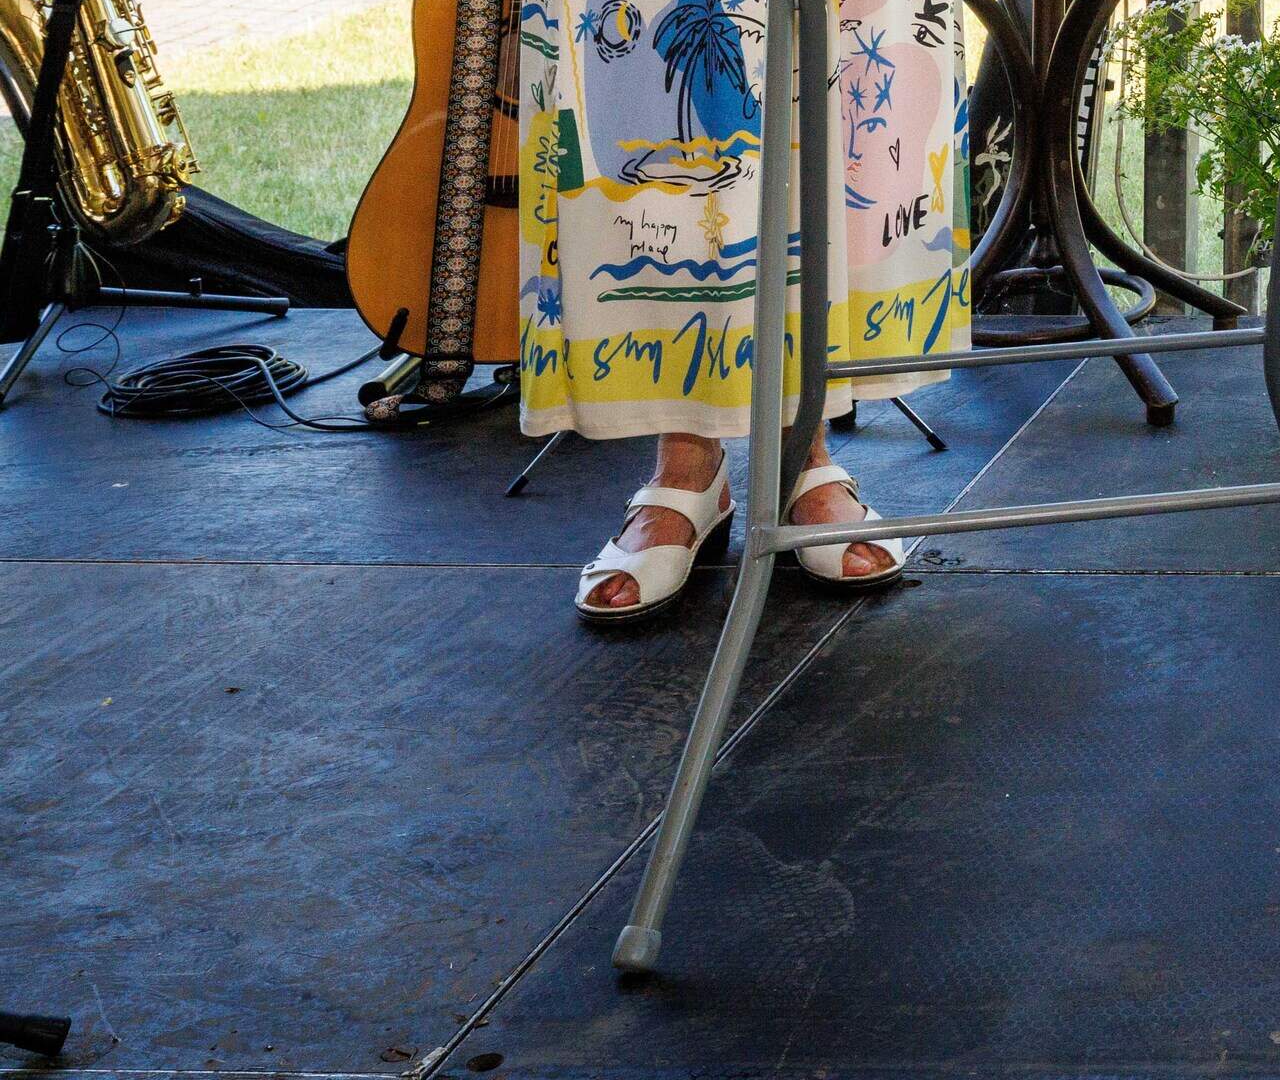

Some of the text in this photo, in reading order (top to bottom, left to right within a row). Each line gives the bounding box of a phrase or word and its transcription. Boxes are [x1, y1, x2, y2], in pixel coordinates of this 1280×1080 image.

[614, 208, 678, 245] my happy
[882, 194, 929, 248] LOVE
